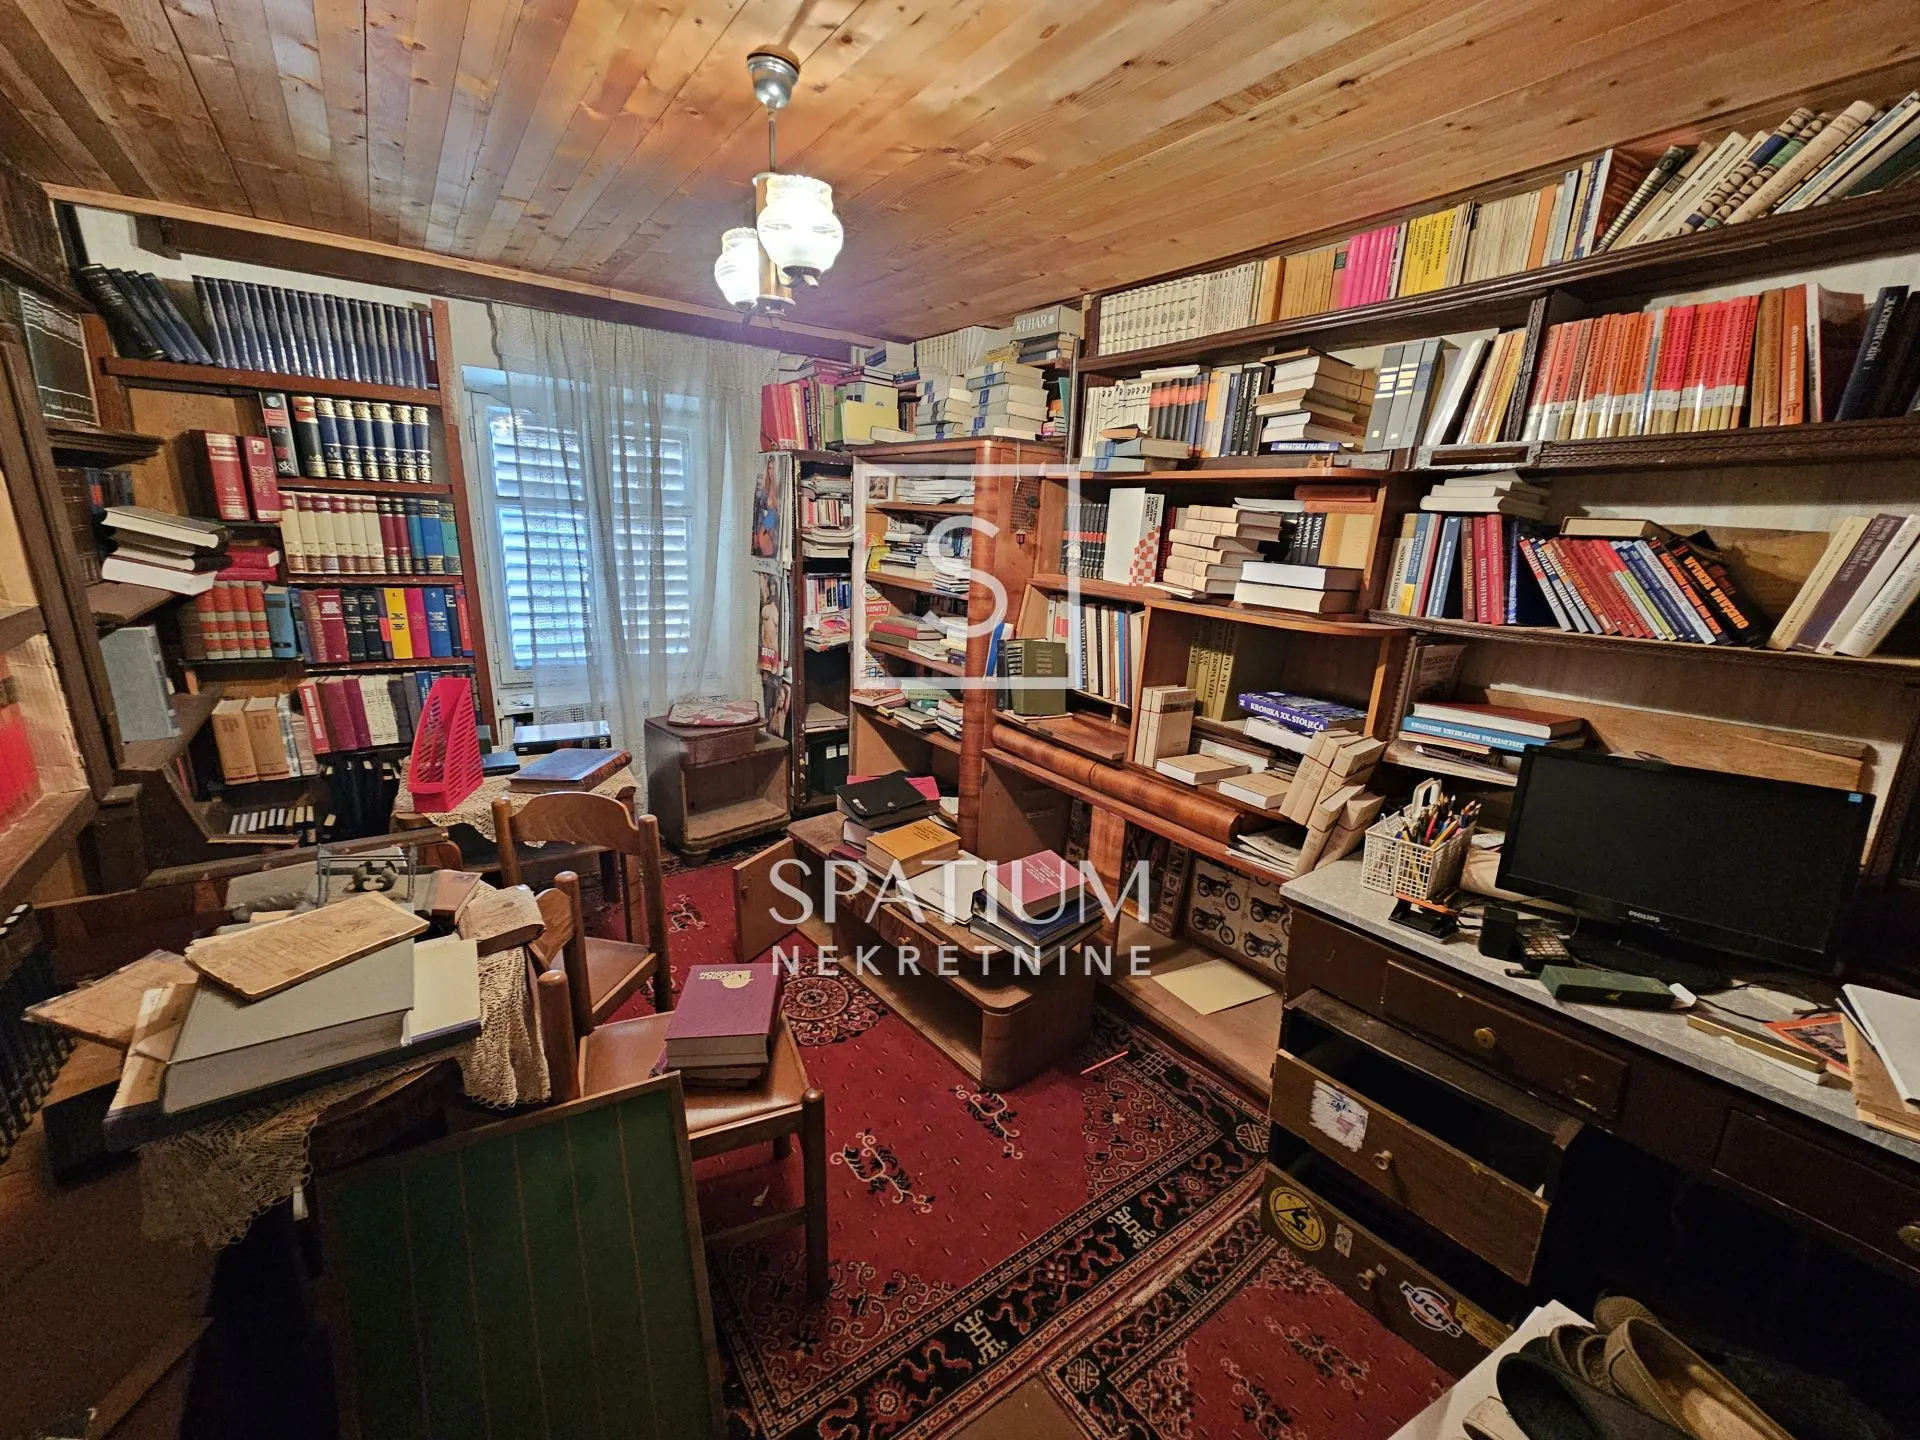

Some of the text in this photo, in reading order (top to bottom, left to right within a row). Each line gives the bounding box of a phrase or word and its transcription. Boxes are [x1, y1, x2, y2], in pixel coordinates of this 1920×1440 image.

[1015, 315, 1047, 334] KUHAR
[1523, 545, 1560, 608] POVIJEST SVIJETA
[1534, 547, 1575, 610] POVIJEST SVIJETA
[1546, 549, 1587, 612] POVIJEST SVIJETA
[1684, 556, 1750, 629] OBEĆANA ZEMLJA
[1250, 702, 1324, 731] KRONIKA XX. STOLJEĆA
[1628, 910, 1660, 923] PHILIPS
[1401, 1283, 1462, 1338] FUCHS
